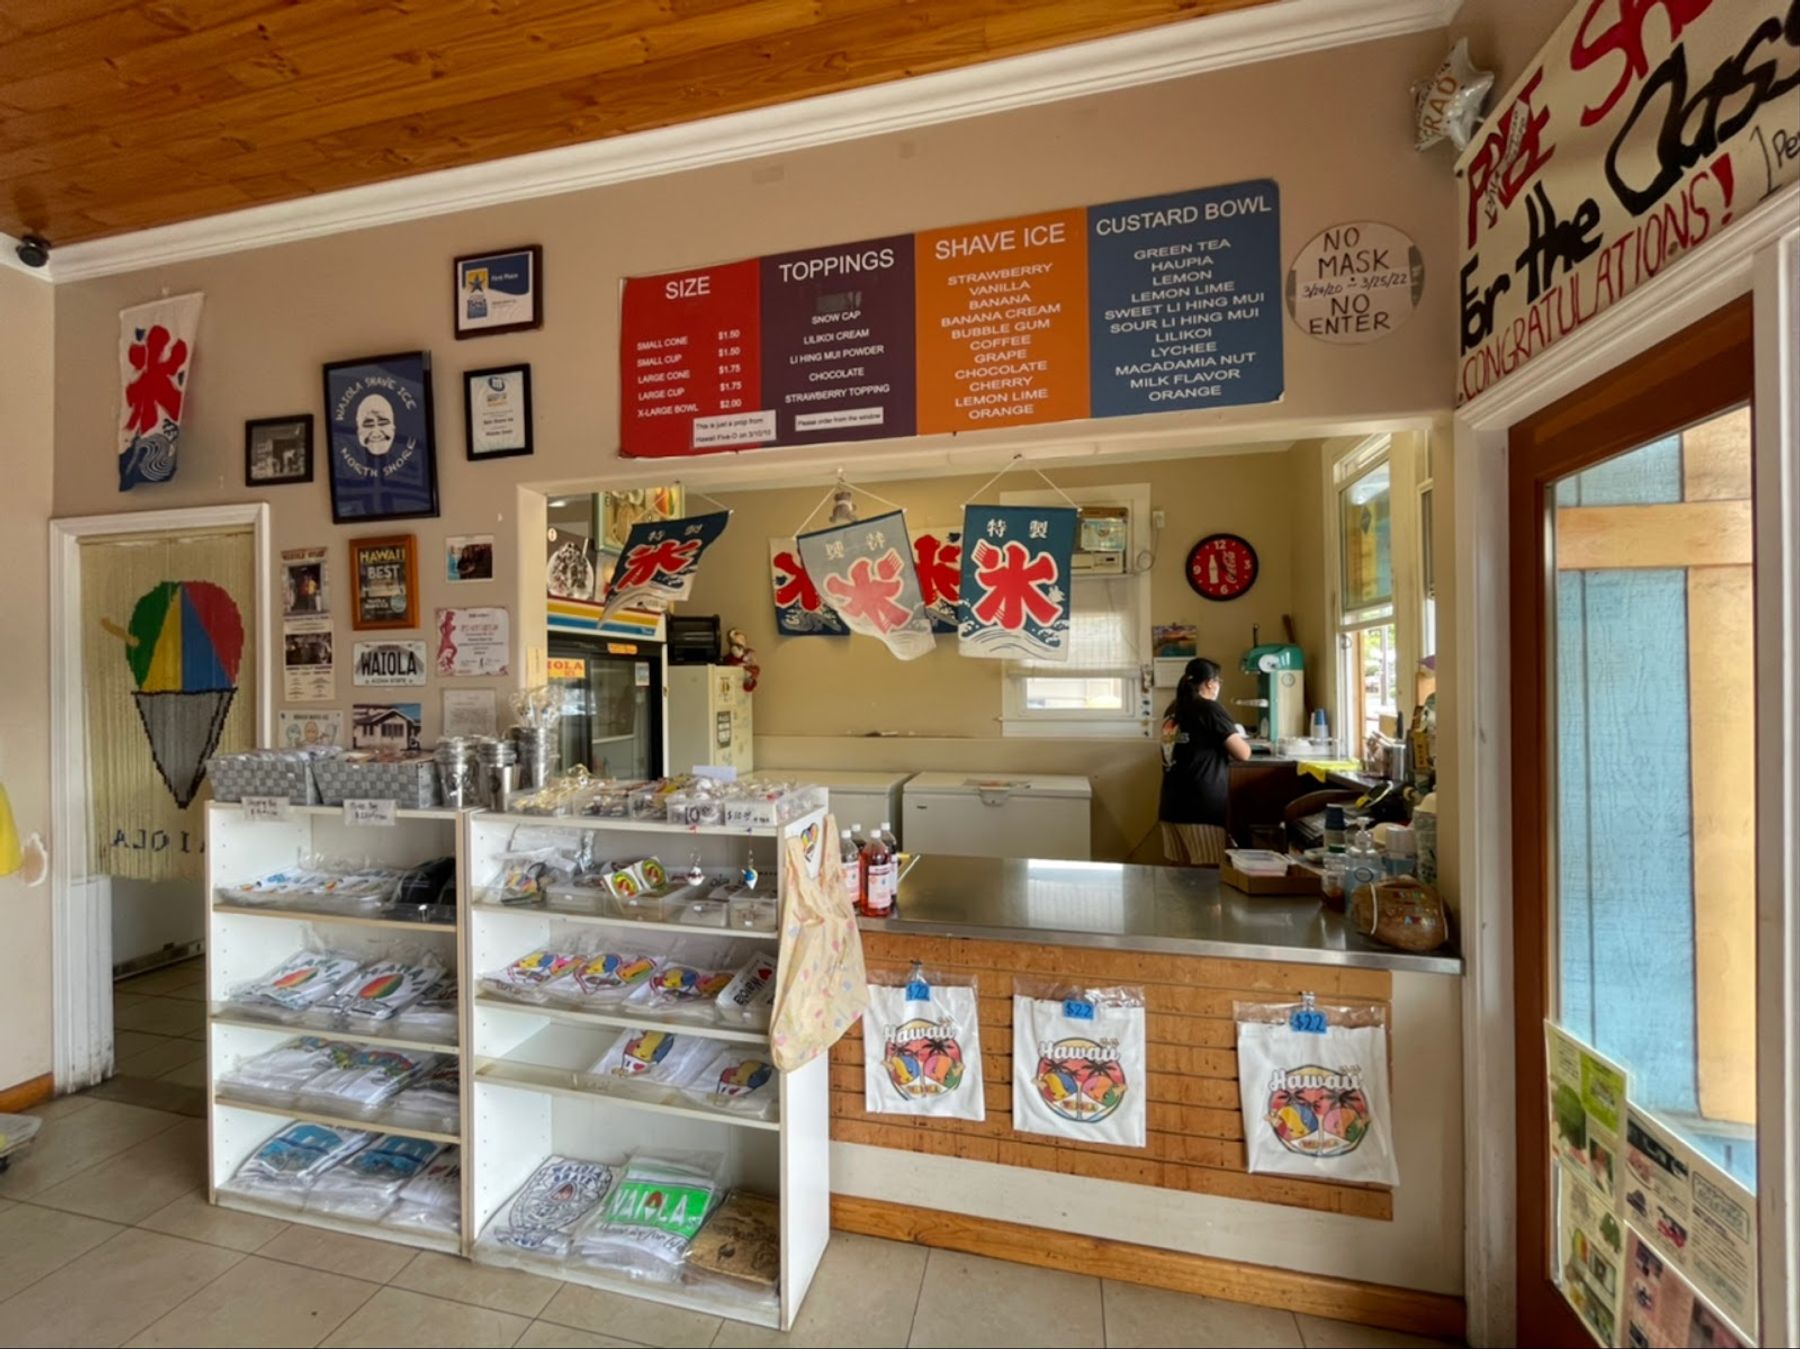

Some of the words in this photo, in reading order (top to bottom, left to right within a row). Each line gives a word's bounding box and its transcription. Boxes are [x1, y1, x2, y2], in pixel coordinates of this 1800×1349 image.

[1096, 206, 1198, 235] CUSTARD
[1205, 196, 1272, 220] BOWL
[935, 230, 1016, 260] SHAVE
[1024, 223, 1065, 247] ICE
[1324, 227, 1359, 252] NO
[1134, 244, 1192, 260] GREEN
[1198, 239, 1231, 251] TEA
[779, 248, 894, 283] TOPPINGS
[1151, 255, 1214, 272] HAUPIA
[1318, 249, 1389, 279] MASK
[1461, 253, 1511, 357] For
[1516, 180, 1603, 304] the
[948, 263, 1053, 286] STRAWBERRY
[1153, 270, 1212, 286] LEMON
[665, 276, 711, 299] SIZE
[969, 280, 1031, 296] VANILLA
[1131, 288, 1190, 303] LEMON
[1195, 281, 1235, 296] LIME
[969, 294, 1031, 310] BANANA
[1105, 304, 1162, 320] SWEET
[1167, 302, 1180, 313] LI
[1186, 296, 1228, 311] HING
[1233, 293, 1264, 305] MUI
[1331, 294, 1370, 317] NO
[812, 313, 839, 325] SNOW
[842, 310, 861, 321] CAP
[941, 312, 1002, 327] BANANA
[1005, 304, 1061, 319] CREAM
[1110, 319, 1157, 334] SOUR
[1162, 316, 1175, 328] LI
[1180, 312, 1223, 326] HING
[1228, 308, 1259, 320] MUI
[1309, 312, 1391, 334] ENTER
[803, 332, 834, 345] LILIKOI
[836, 329, 869, 340] CREAM
[951, 323, 1010, 339] BUBBLE
[1014, 319, 1051, 331] GUM
[1156, 328, 1212, 343] LILIKOI
[637, 339, 663, 351] SMALL
[664, 336, 688, 347] CONE
[718, 329, 740, 340] $1.50
[970, 335, 1031, 351] COFFEE
[637, 356, 663, 367] SMALL
[664, 354, 682, 364] CUP
[718, 347, 740, 357] $1.50
[790, 354, 798, 364] LI
[799, 352, 822, 363] HING
[824, 350, 840, 360] MUI
[843, 345, 884, 358] POWDER
[974, 349, 1027, 364] GRAPE
[1151, 342, 1217, 358] LYCHEE
[955, 361, 1047, 379] CHOCOLATE
[1115, 357, 1216, 376] MACADAMIA
[1220, 352, 1256, 366] NUT
[638, 373, 665, 384] LARGE
[666, 370, 690, 380] CONE
[719, 364, 740, 375] $1.75
[809, 367, 864, 381] CHOCOLATE
[1130, 378, 1169, 388] MILK
[1174, 369, 1240, 386] FLAVOR
[638, 390, 665, 401] LARGE
[667, 387, 685, 397] CUP
[720, 381, 742, 392] $1.75
[969, 376, 1033, 392] CHERRY
[1149, 385, 1222, 401] ORANGE
[785, 389, 847, 404] STRAWBERRY
[849, 384, 890, 396] TOPPING
[955, 393, 1007, 407] LEMON
[1012, 389, 1048, 402] LIME
[637, 405, 673, 417] X-LARGE
[674, 403, 698, 414] BOWL
[720, 399, 742, 409] $2.00
[969, 404, 1034, 420] ORANGE
[986, 518, 1049, 540] 特製
[1214, 540, 1226, 550] 12
[368, 565, 400, 579] BEST
[1193, 565, 1201, 575] 9
[1244, 560, 1252, 570] 3
[972, 538, 1062, 631] 氷
[1220, 584, 1228, 595] 6
[361, 651, 417, 676] WAIOLA
[1066, 1002, 1092, 1017] $22
[1295, 1014, 1325, 1032] $22
[884, 1024, 958, 1043] Hawaii
[1040, 1041, 1120, 1060] Hawaii
[1269, 1068, 1361, 1090] Hawaii
